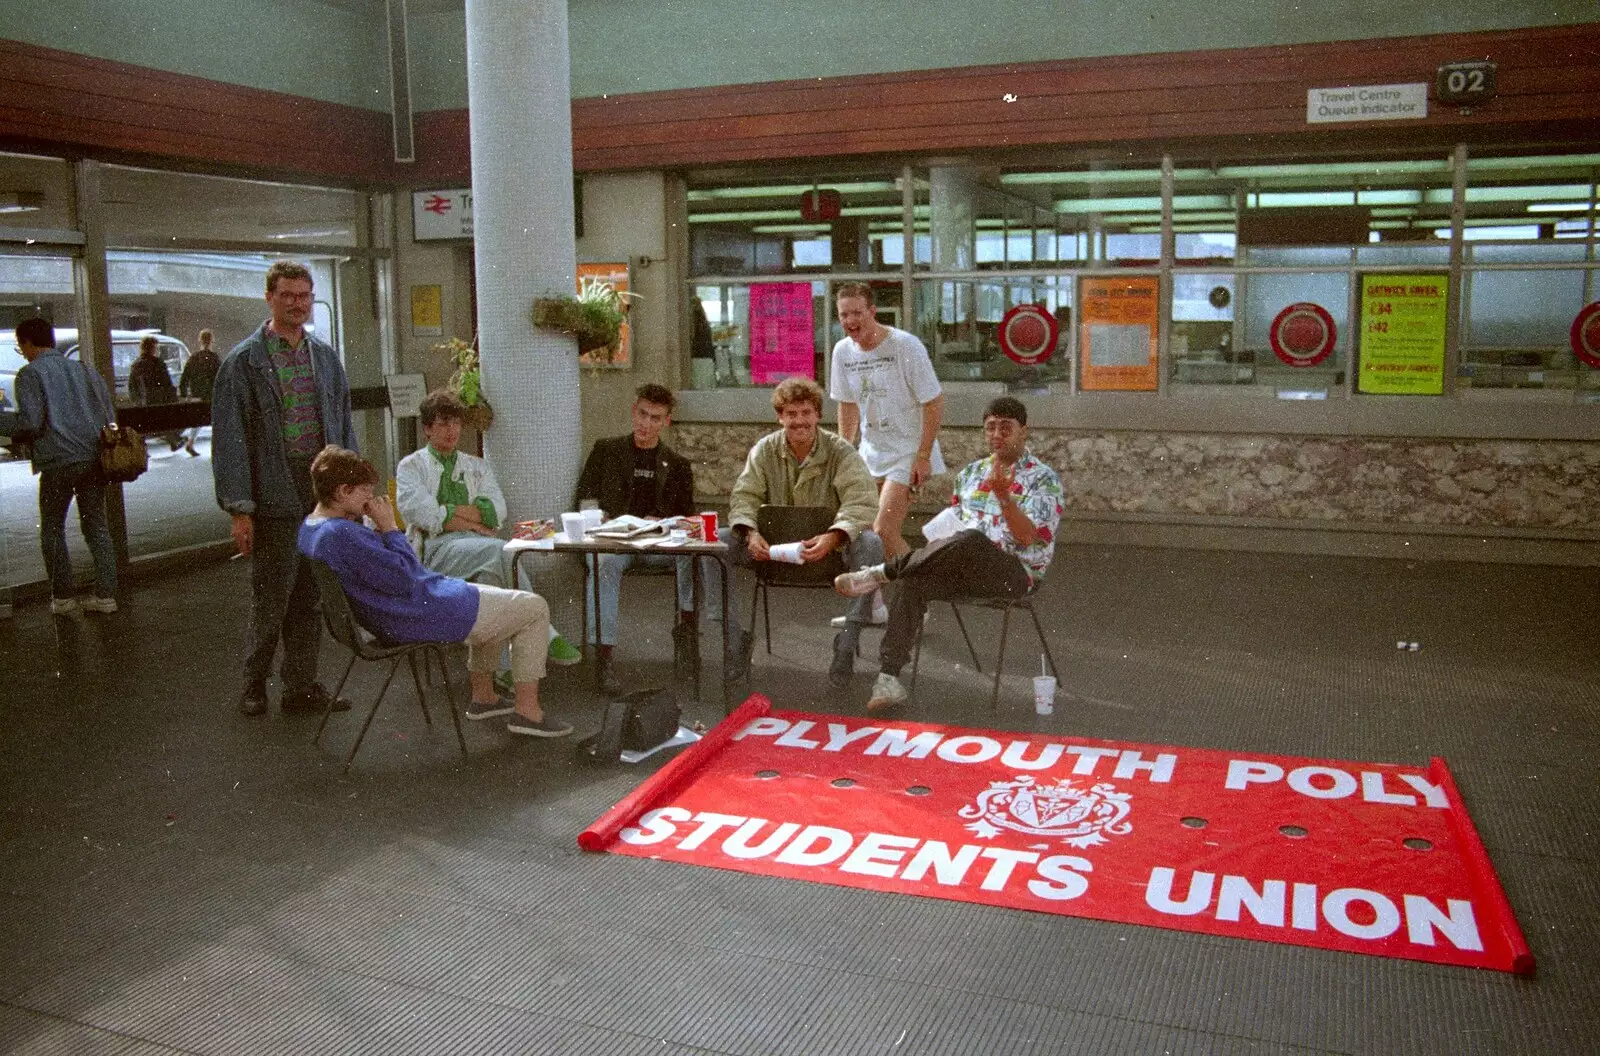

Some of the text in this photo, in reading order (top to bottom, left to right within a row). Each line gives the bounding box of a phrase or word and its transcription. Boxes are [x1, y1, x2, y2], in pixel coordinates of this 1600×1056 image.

[1448, 69, 1485, 93] 02
[1319, 89, 1401, 104] Travel Centre
[1318, 102, 1416, 118] Queue Indicator
[733, 716, 1452, 810] PLYMOUTH POLY
[1145, 867, 1485, 953] UNION
